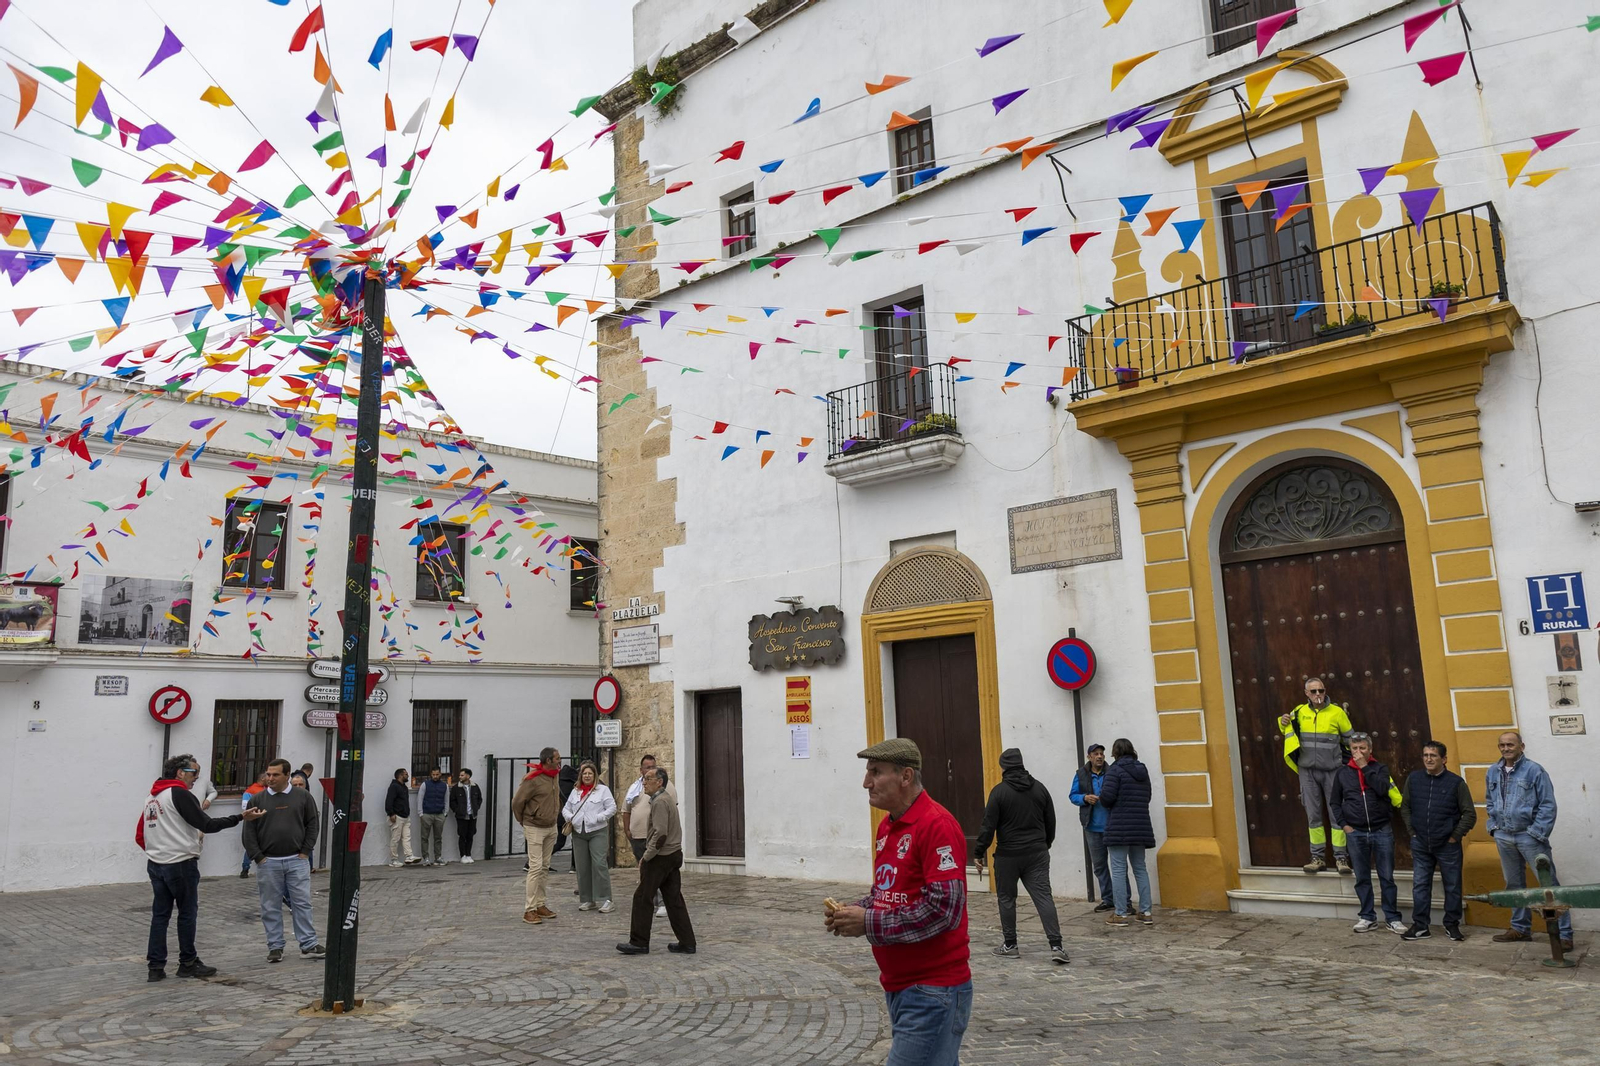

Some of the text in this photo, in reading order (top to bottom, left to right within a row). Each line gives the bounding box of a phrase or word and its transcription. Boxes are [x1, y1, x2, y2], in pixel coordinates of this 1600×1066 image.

[1532, 575, 1581, 612] H
[630, 598, 640, 608] LA
[612, 605, 658, 620] PLAZUELA
[801, 616, 838, 632] Convento
[1519, 620, 1530, 636] 6
[1542, 620, 1582, 630] RURAL
[766, 636, 832, 653] San Francisco
[34, 700, 40, 710] 8
[789, 715, 810, 723] ASEOS
